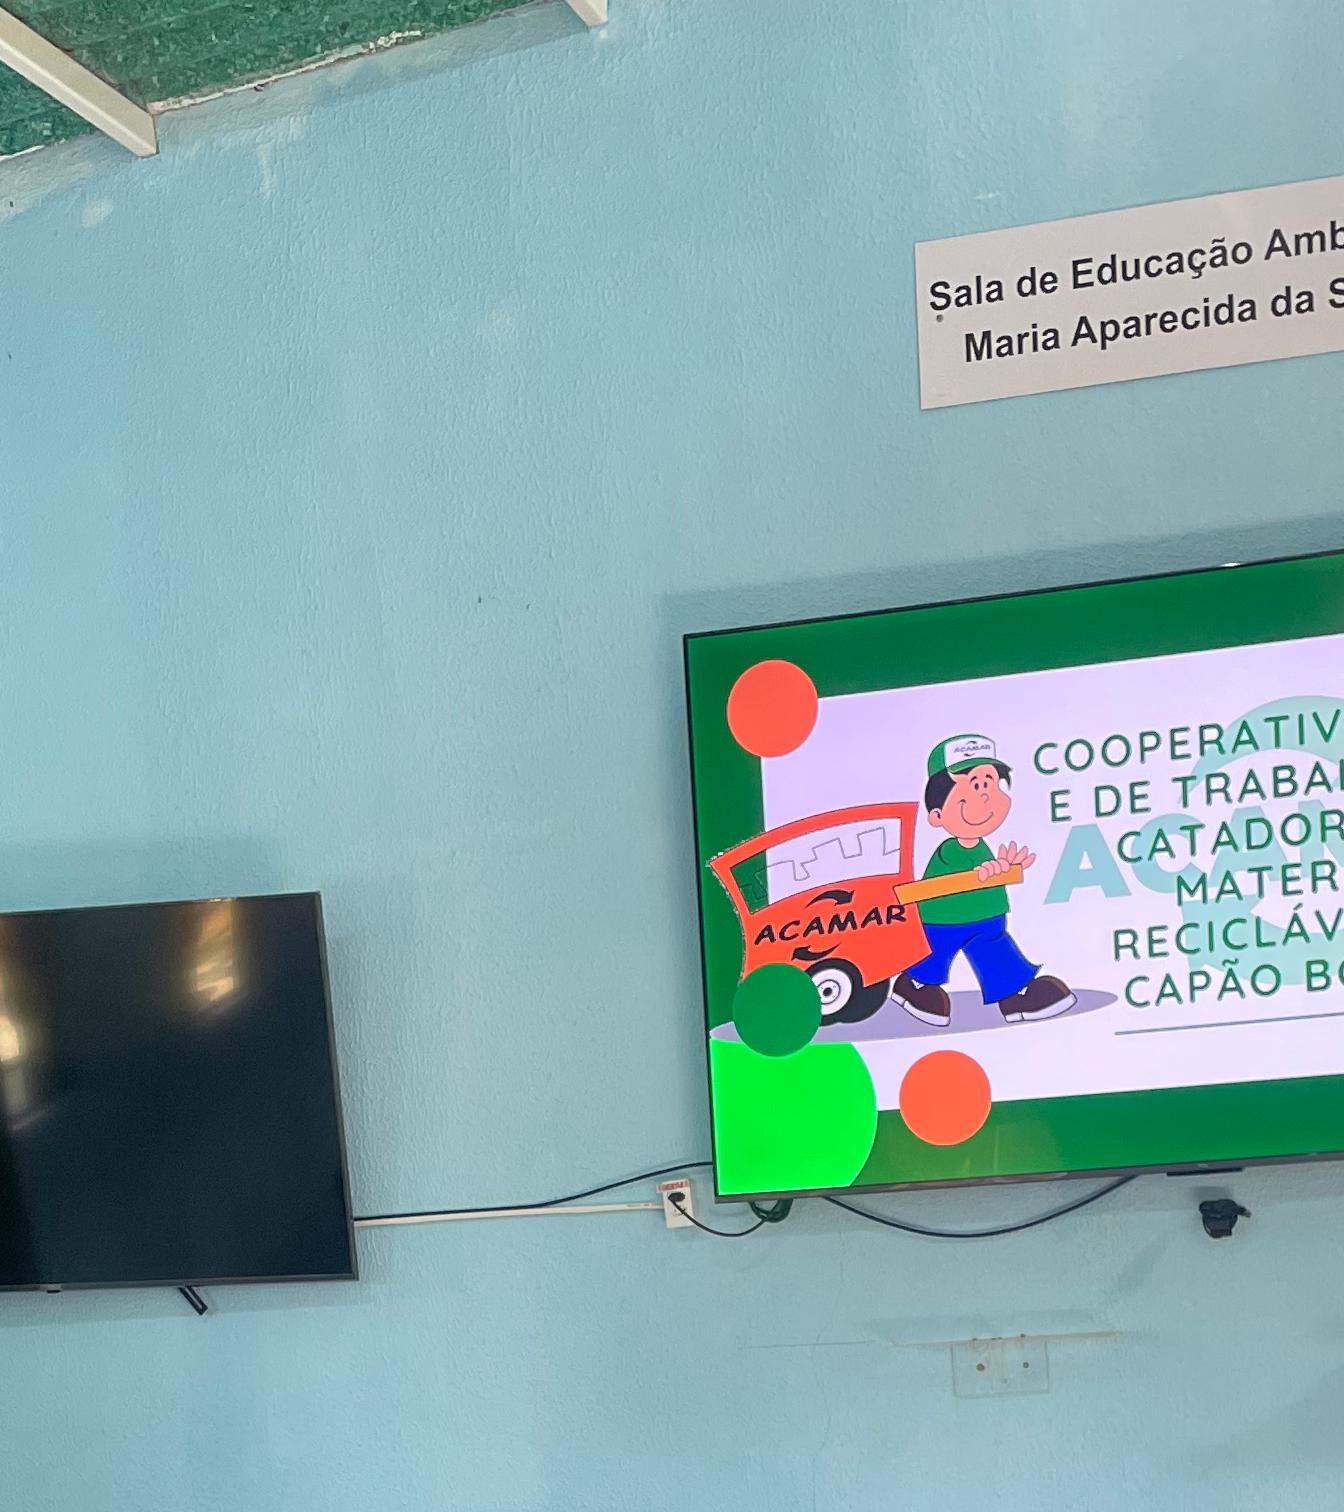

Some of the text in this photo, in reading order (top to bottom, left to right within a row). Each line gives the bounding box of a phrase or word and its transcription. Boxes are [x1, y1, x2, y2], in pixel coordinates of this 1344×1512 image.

[929, 274, 1004, 312] Sala
[1016, 265, 1059, 298] de
[1072, 237, 1253, 290] Educação
[965, 317, 1061, 362] Maria
[1071, 289, 1257, 350] Aparecida
[1270, 285, 1315, 318] da
[1050, 789, 1071, 822] E
[1094, 780, 1152, 818] DE
[754, 904, 907, 946] ACAMAR
[1124, 958, 1283, 1008] CAPÃO
